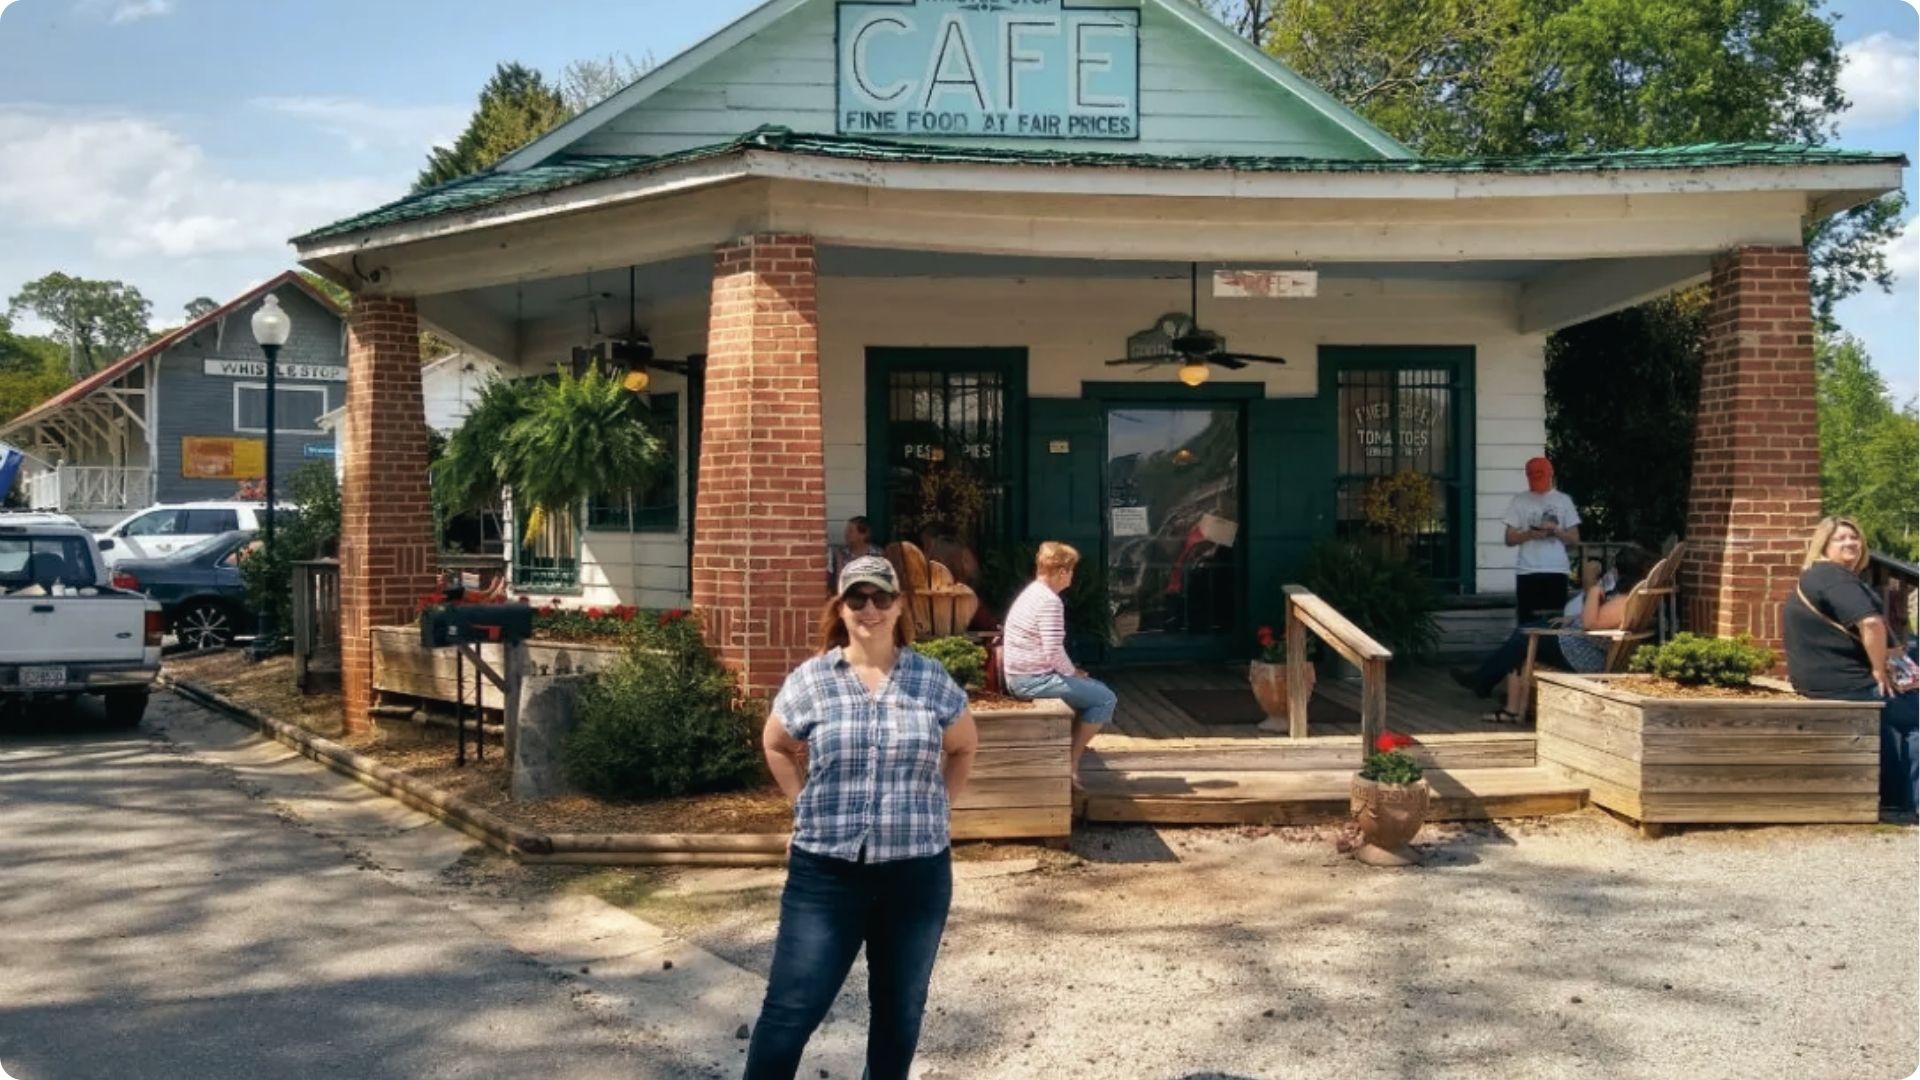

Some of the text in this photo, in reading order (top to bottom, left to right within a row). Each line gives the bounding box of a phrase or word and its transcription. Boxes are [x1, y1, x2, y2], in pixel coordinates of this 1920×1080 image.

[847, 10, 1129, 111] CAFE
[845, 111, 1130, 134] FINE FOOD AT FAIR PRICES
[222, 362, 297, 377] WHISLE
